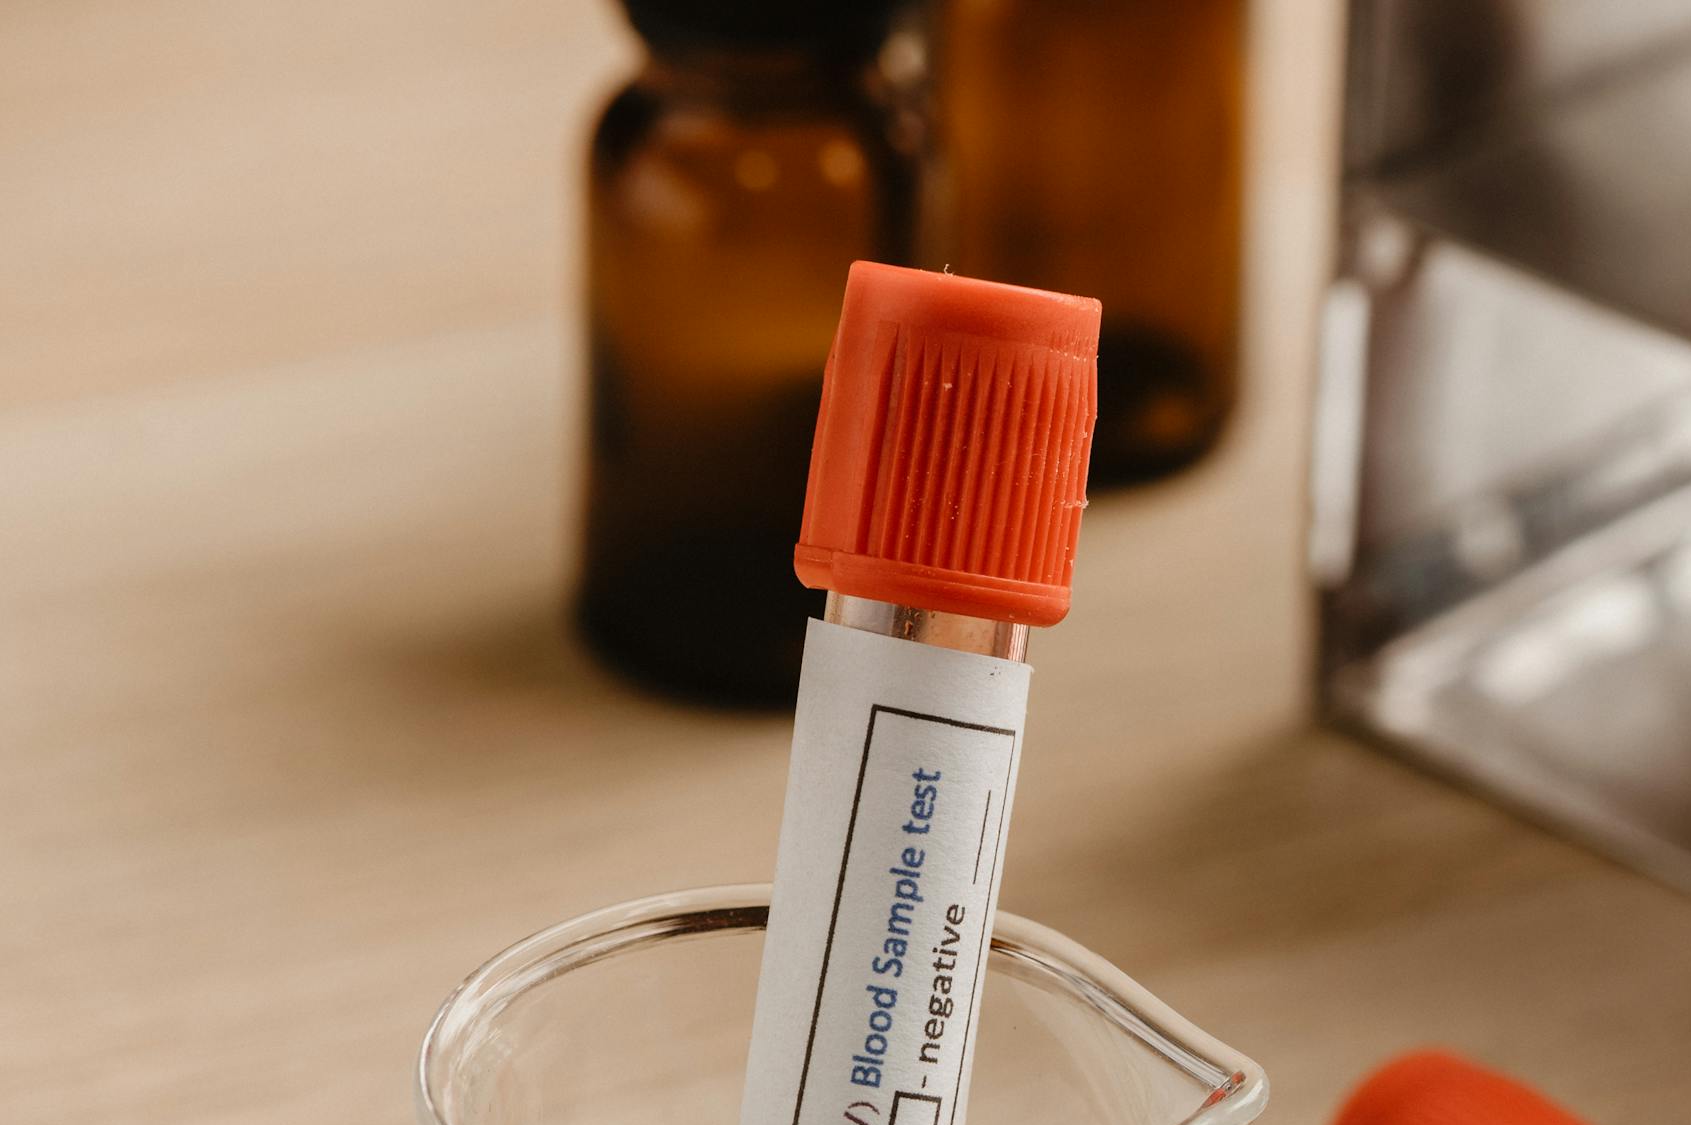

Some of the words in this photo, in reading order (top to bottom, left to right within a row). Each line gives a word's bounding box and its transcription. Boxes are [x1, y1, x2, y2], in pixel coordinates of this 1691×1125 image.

[902, 767, 941, 835] test
[872, 846, 926, 978] Sample
[850, 985, 898, 1088] Blood
[919, 903, 965, 1064] negative
